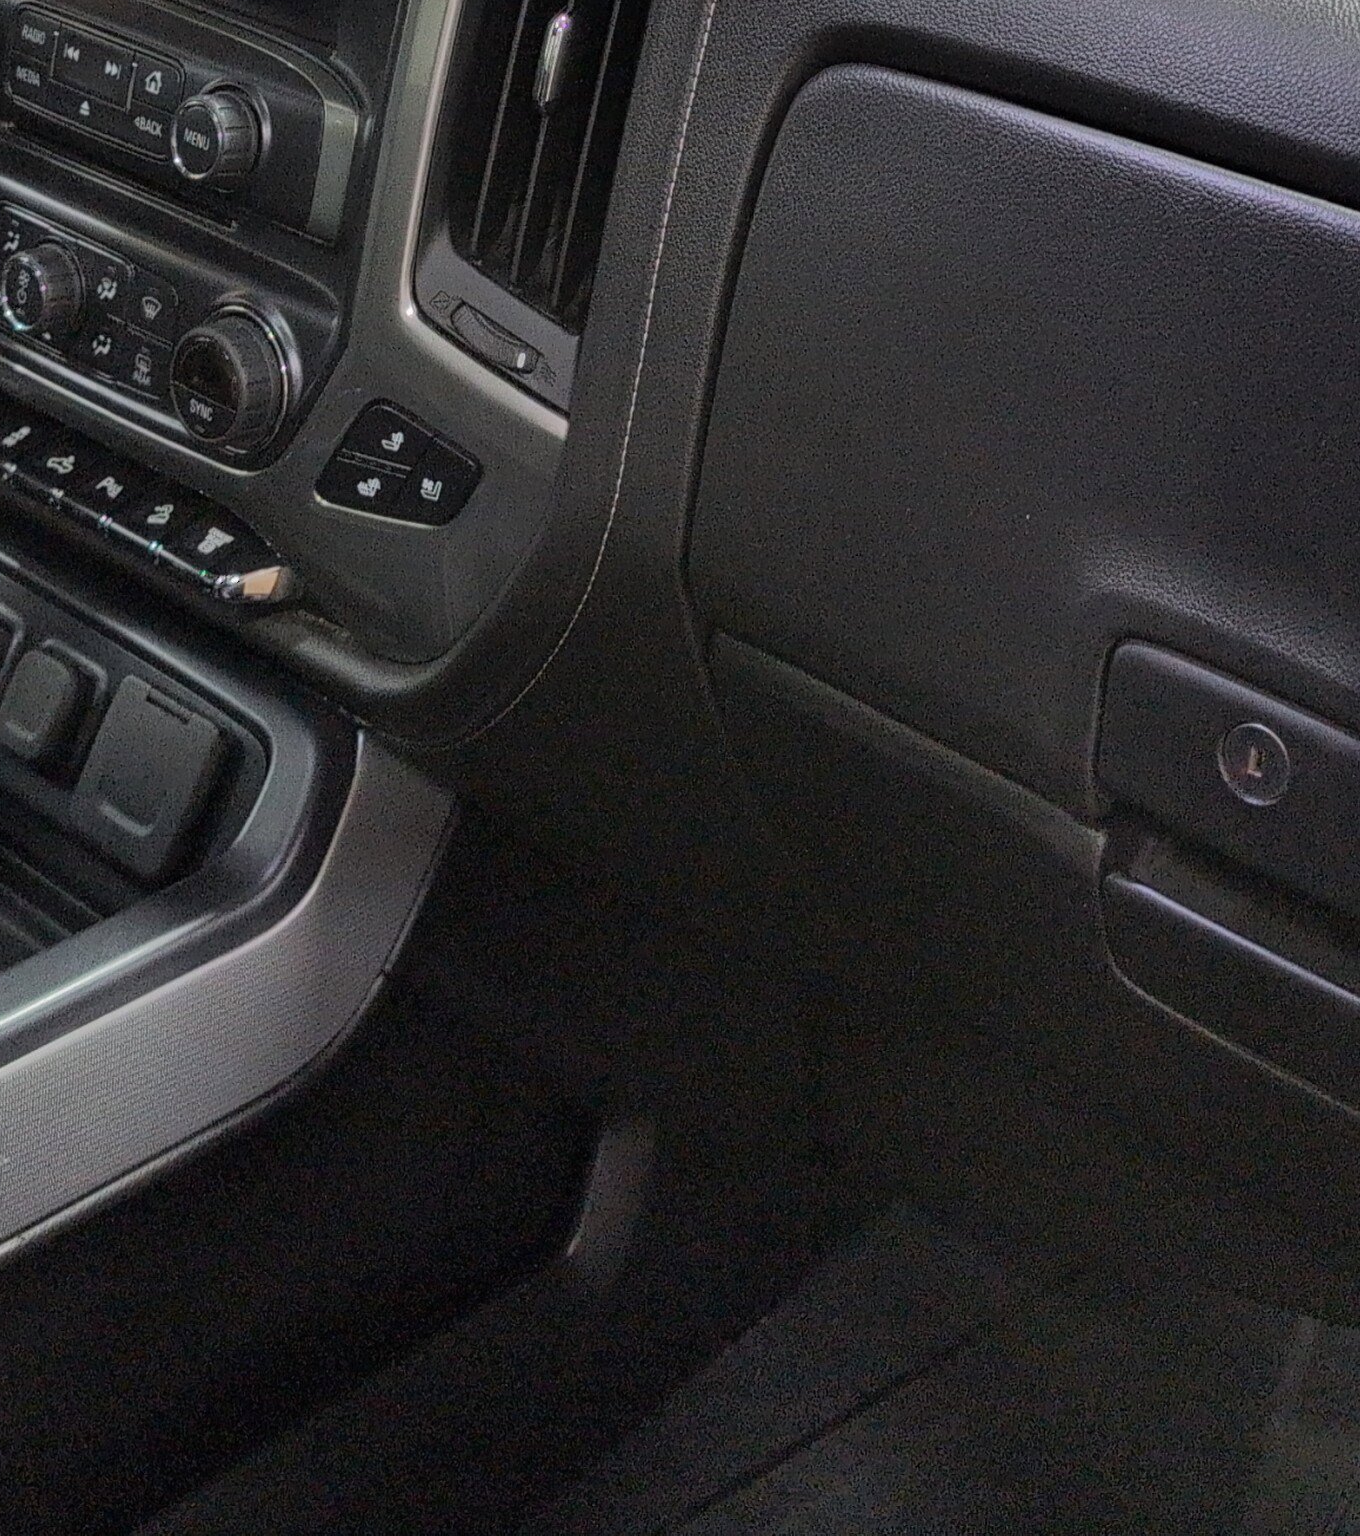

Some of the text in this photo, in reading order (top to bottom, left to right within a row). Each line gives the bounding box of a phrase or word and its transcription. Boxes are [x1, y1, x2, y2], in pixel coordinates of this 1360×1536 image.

[21, 24, 46, 45] RADIO
[16, 65, 41, 87] MEDIA
[138, 118, 162, 138] BACK
[184, 128, 210, 151] MENU
[190, 399, 213, 421] SYNC
